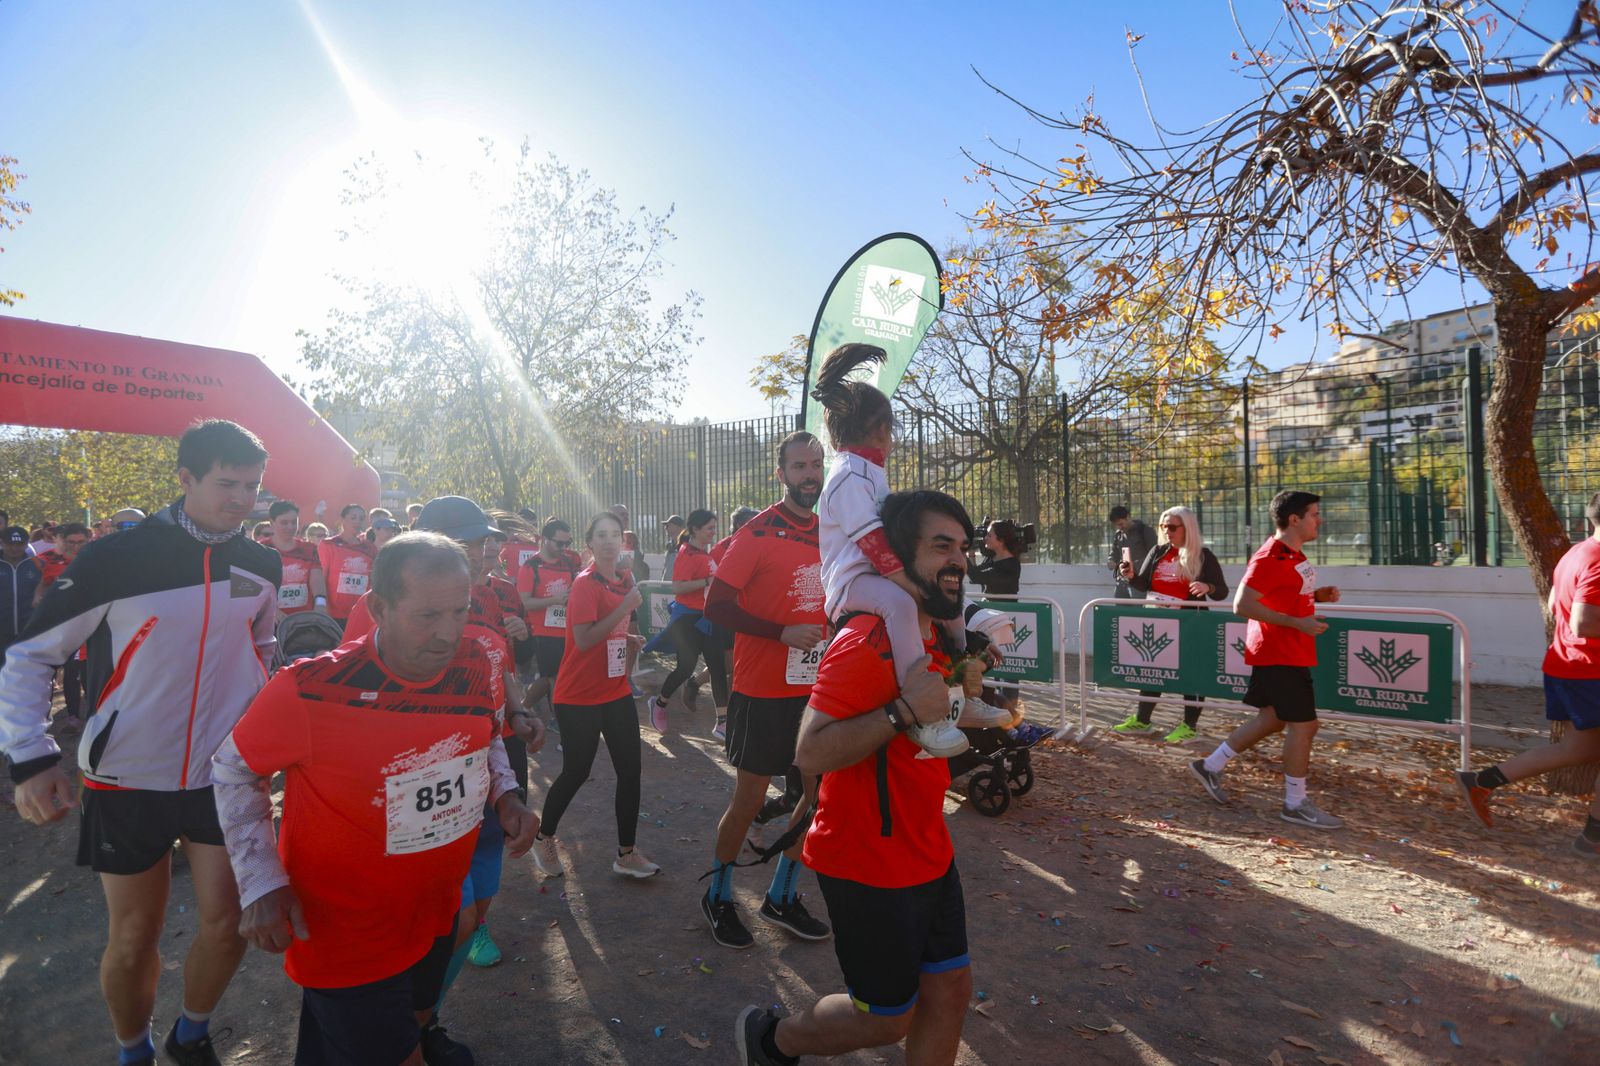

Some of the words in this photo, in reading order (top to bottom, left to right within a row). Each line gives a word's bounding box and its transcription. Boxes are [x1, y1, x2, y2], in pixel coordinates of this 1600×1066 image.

[852, 317, 877, 332] CAJA
[880, 321, 913, 337] RURAL
[865, 328, 900, 341] GRANADA
[0, 352, 107, 376] TAMIENTO
[112, 365, 135, 378] DE
[0, 370, 86, 391] ncejalía
[92, 379, 118, 393] de
[125, 382, 204, 402] Deportes
[345, 577, 361, 586] 218
[282, 589, 300, 598] 220
[1216, 624, 1224, 673] fundación
[1006, 658, 1038, 668] RURAL
[1337, 631, 1346, 685] fundación
[1111, 666, 1137, 676] CAJA
[1140, 668, 1179, 680] RURAL
[1216, 675, 1247, 686] CAJA
[1125, 676, 1164, 686] GRANADA
[1338, 687, 1372, 699] CAJA
[1376, 690, 1429, 704] RURAL
[1356, 699, 1408, 711] GRANADA
[416, 774, 466, 813] 851
[431, 805, 463, 822] ANTONIO
